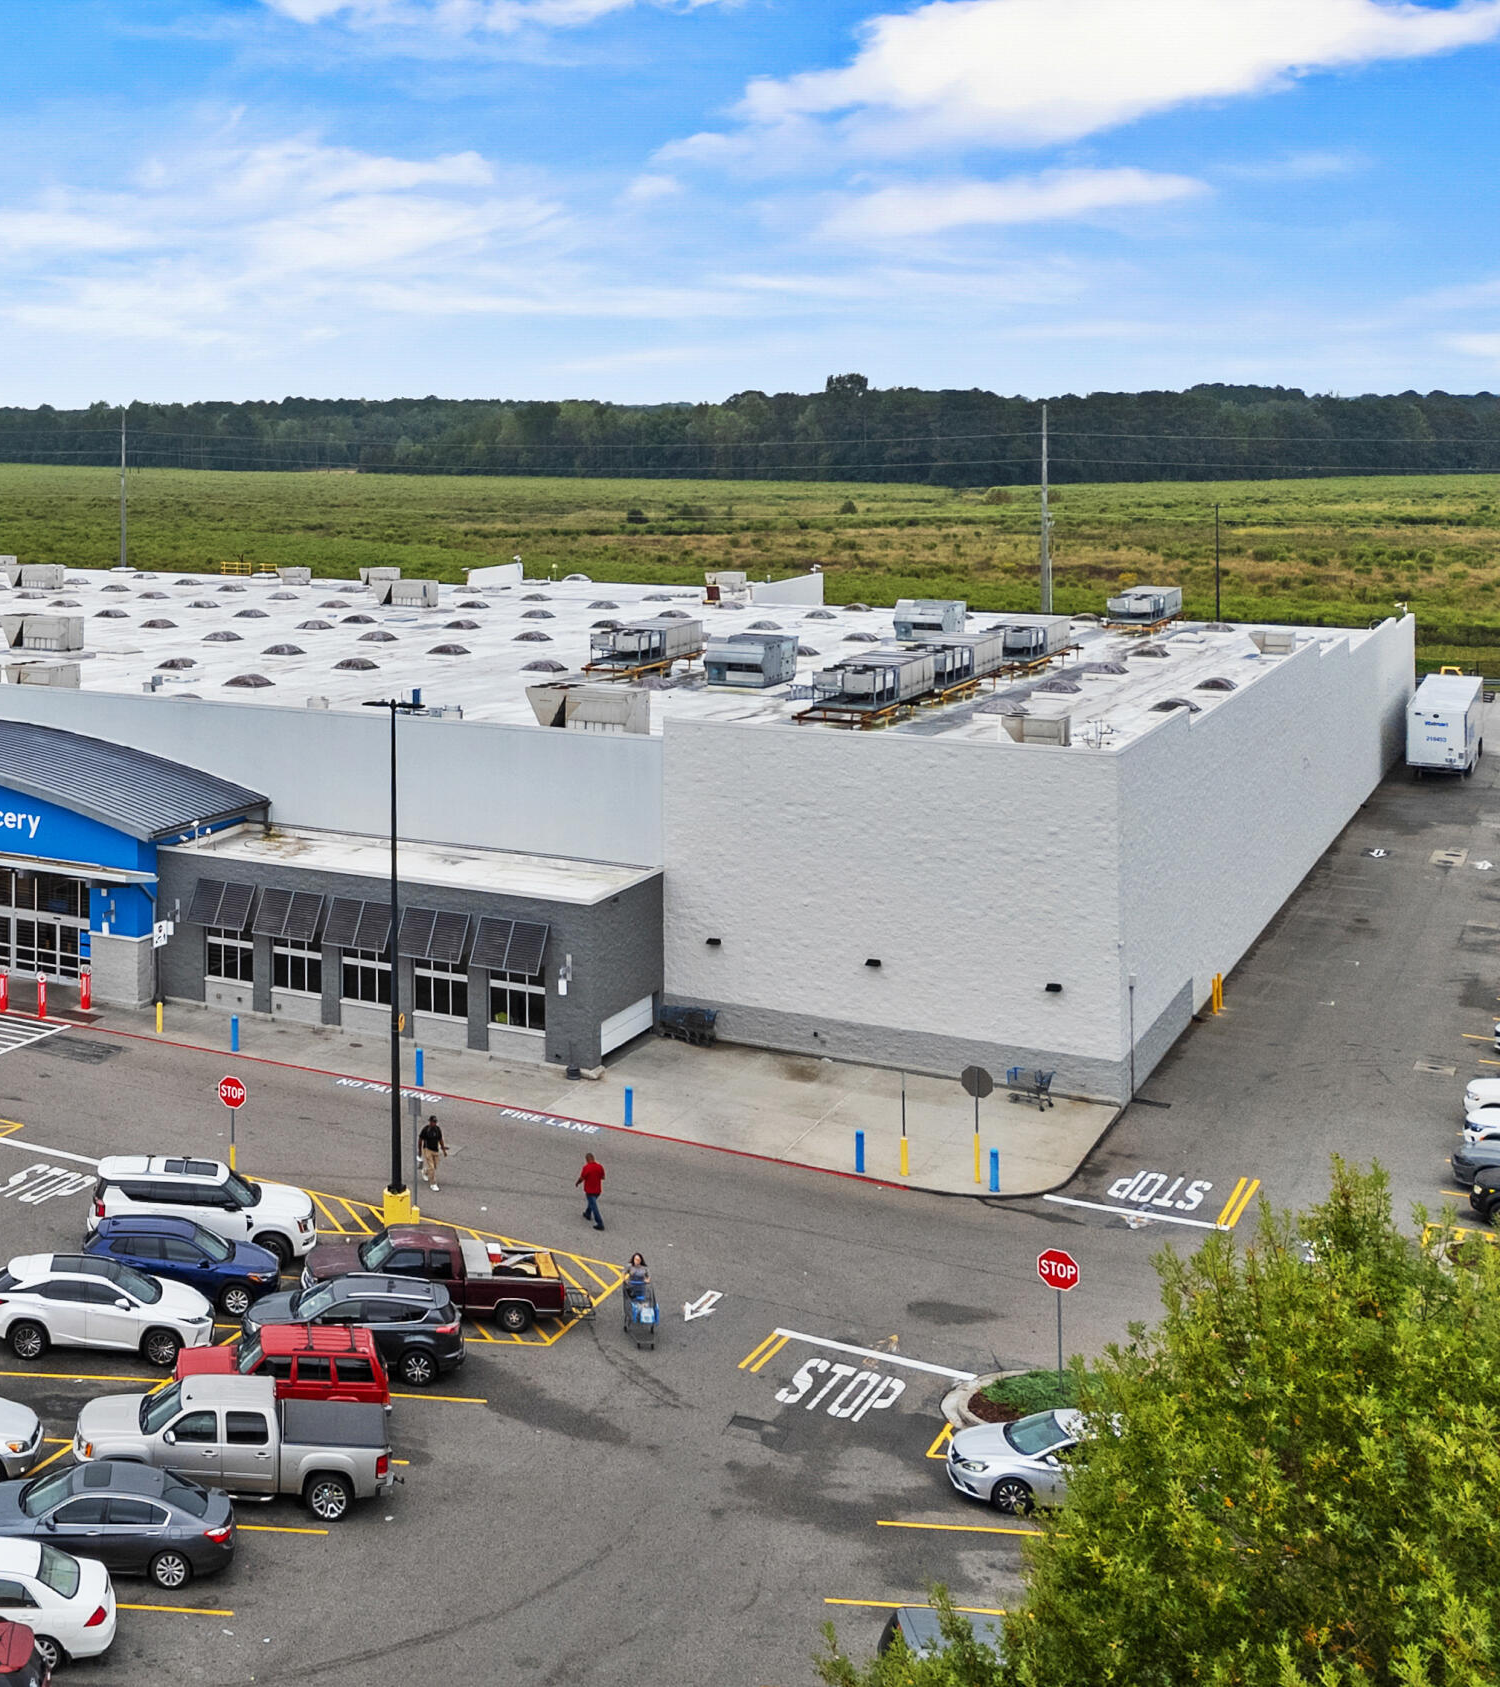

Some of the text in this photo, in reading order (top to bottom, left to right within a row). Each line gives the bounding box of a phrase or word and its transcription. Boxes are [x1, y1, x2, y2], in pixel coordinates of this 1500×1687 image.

[220, 1084, 244, 1100] STOP
[336, 1078, 442, 1103] NO PAKING
[500, 1108, 600, 1134] FIRE LANE
[1106, 1170, 1213, 1211] STOP
[1040, 1259, 1077, 1280] STOP
[774, 1358, 907, 1423] STOP
